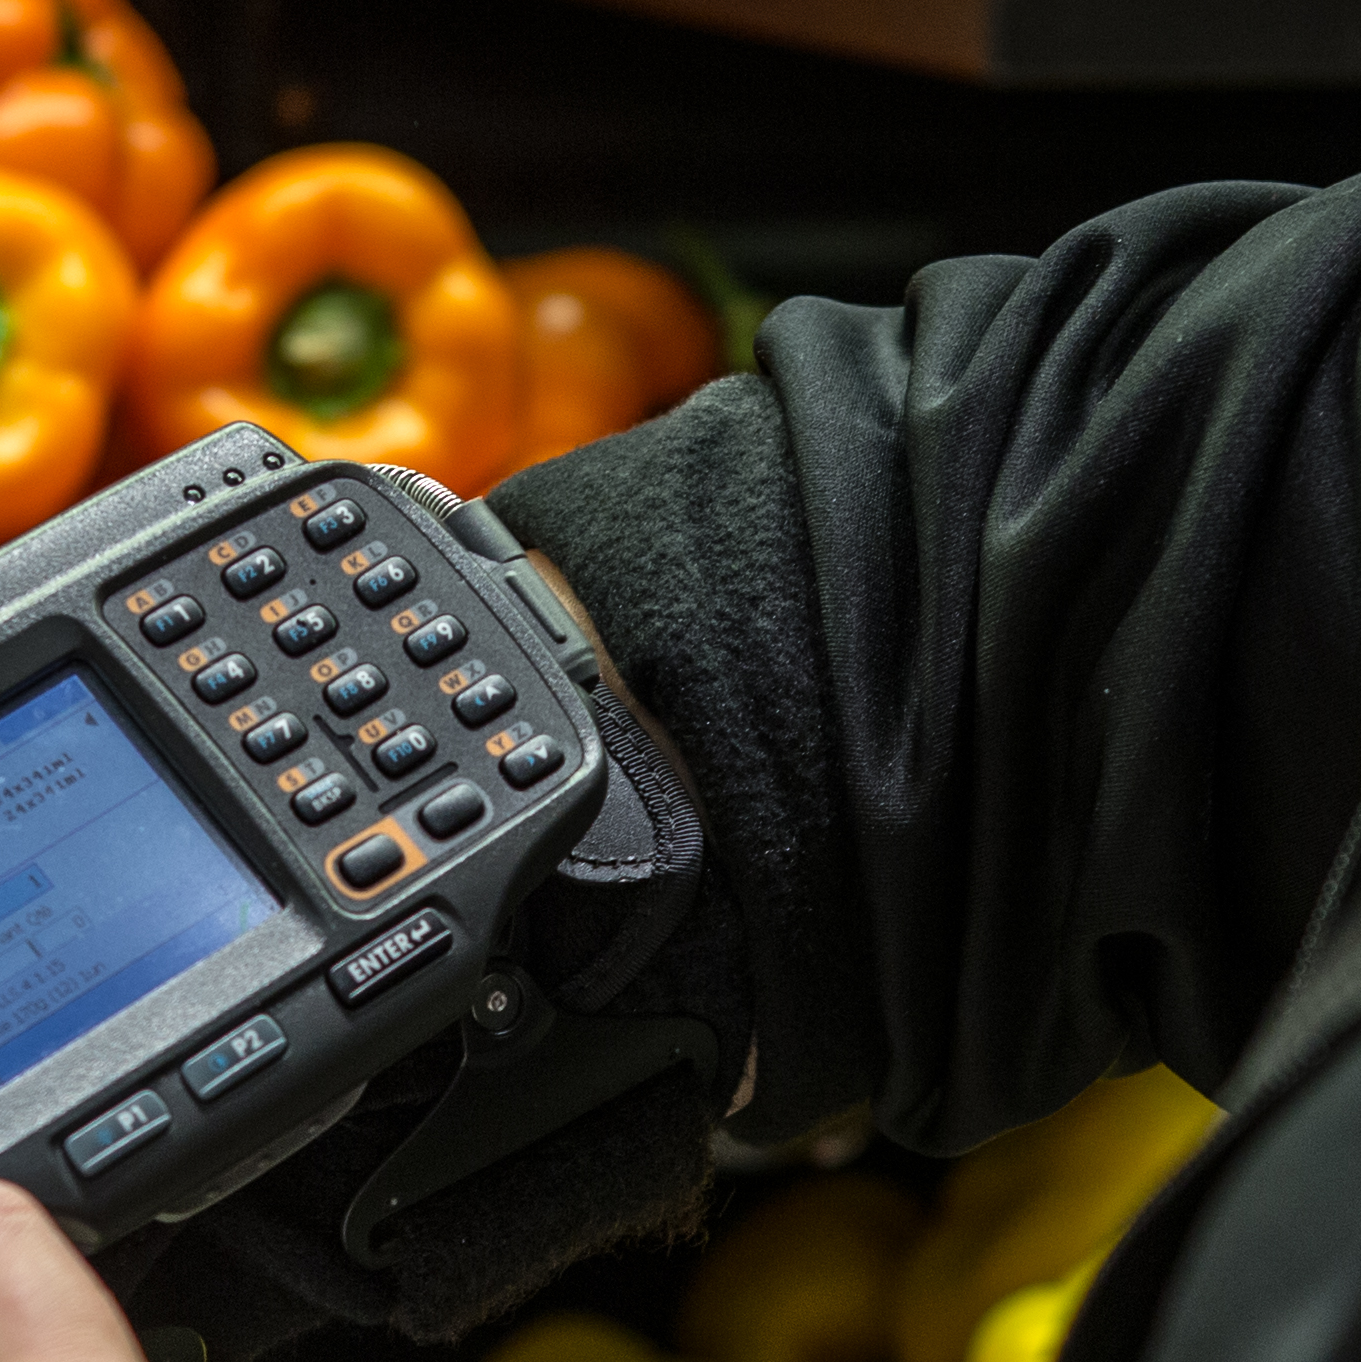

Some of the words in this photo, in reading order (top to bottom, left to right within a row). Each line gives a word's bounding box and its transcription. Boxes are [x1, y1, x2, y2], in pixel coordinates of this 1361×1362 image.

[300, 501, 312, 513] E
[319, 518, 338, 534] F3
[337, 506, 354, 524] 3
[217, 547, 231, 559] C
[236, 536, 250, 548] D
[348, 556, 363, 568] K
[369, 547, 382, 558] L
[239, 566, 257, 583] F2
[256, 555, 275, 574] 2
[369, 576, 388, 591] F6
[388, 564, 404, 581] 6
[137, 597, 149, 609] A
[156, 615, 175, 632] F1
[174, 604, 191, 621] 1
[305, 612, 324, 631] 5
[399, 616, 412, 628] Q
[420, 634, 437, 650] F9
[437, 623, 453, 641] 9
[186, 653, 201, 667] G
[318, 664, 333, 677] O
[207, 674, 227, 690] F4
[226, 661, 245, 679] 4
[356, 671, 375, 689] 8
[444, 674, 461, 689] W
[468, 664, 481, 678] X
[235, 713, 252, 726] M
[365, 727, 381, 739] U
[383, 714, 398, 726] V
[258, 732, 276, 749] F7
[275, 719, 292, 739] 7
[493, 739, 508, 752] Y
[513, 725, 526, 740] Z
[389, 742, 413, 763] F10
[408, 732, 427, 750] 0
[288, 773, 299, 787] S
[306, 761, 318, 774] T
[347, 933, 414, 984] ENTER
[230, 1029, 265, 1058] P2
[116, 1105, 149, 1132] P1
